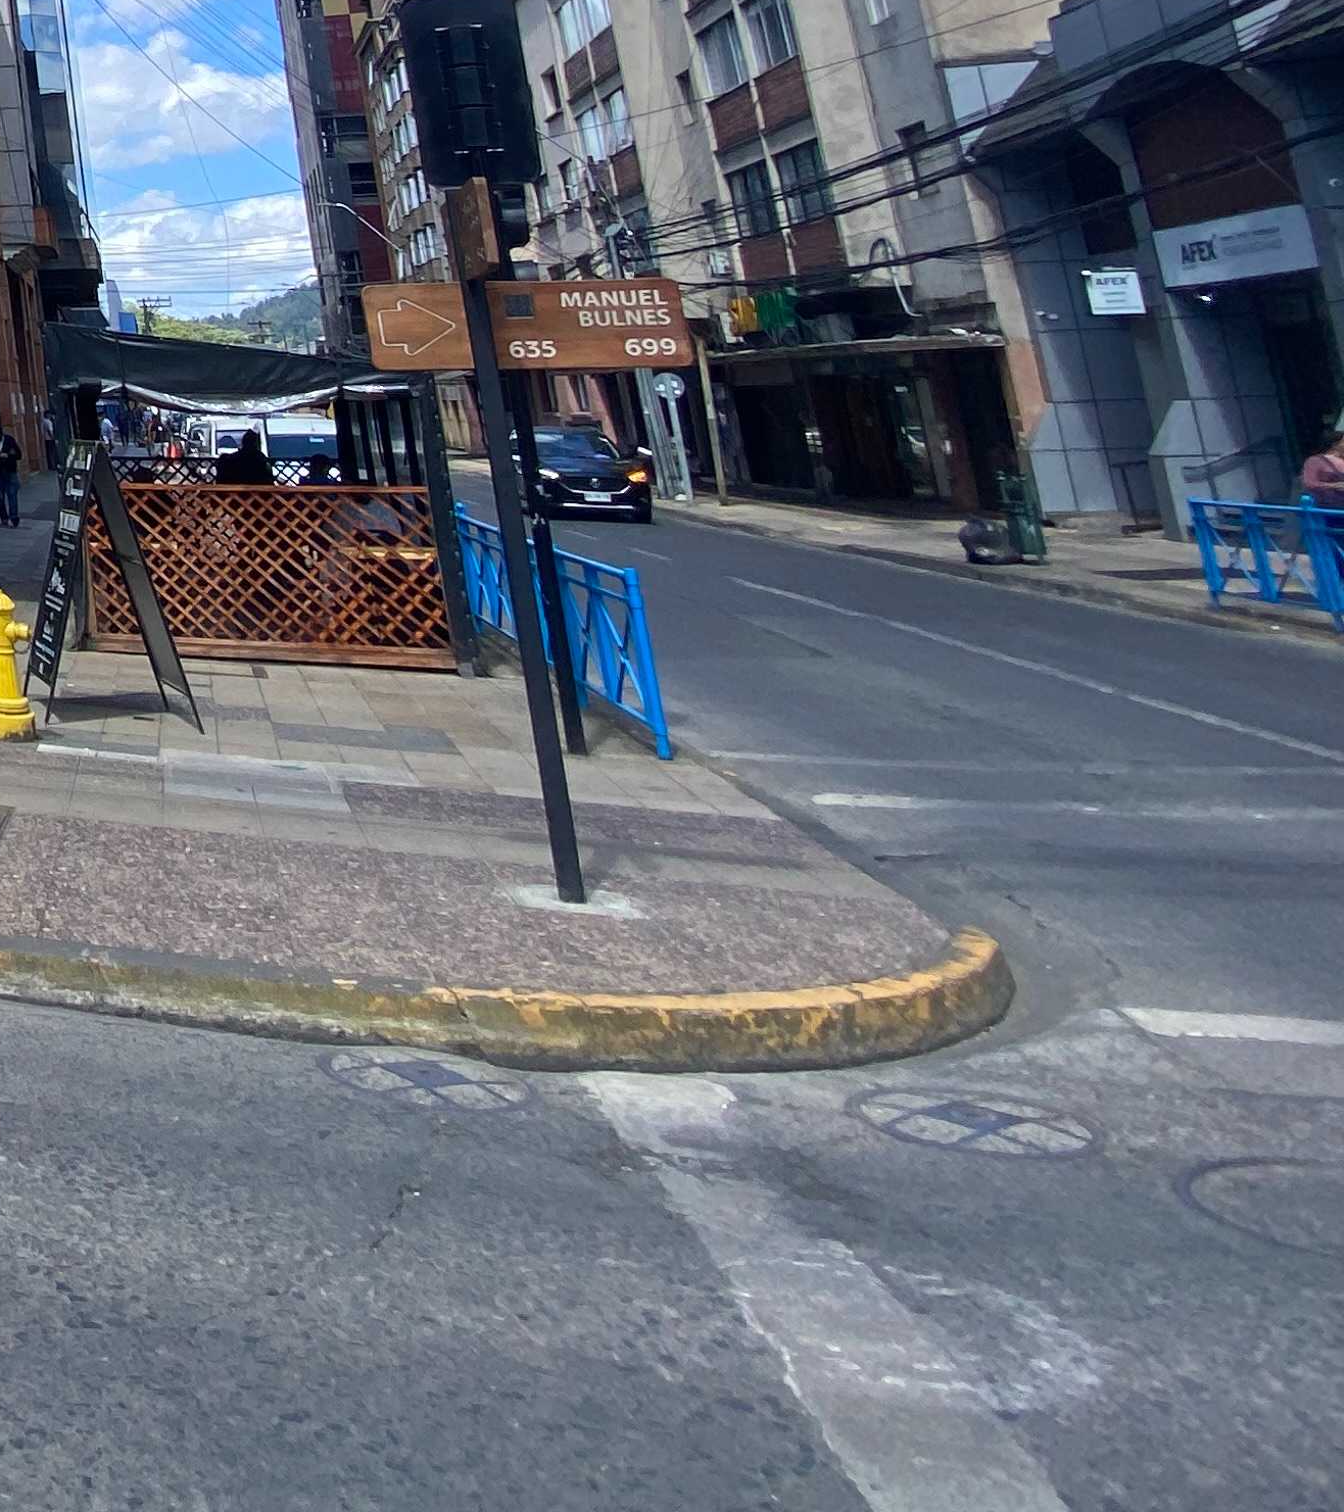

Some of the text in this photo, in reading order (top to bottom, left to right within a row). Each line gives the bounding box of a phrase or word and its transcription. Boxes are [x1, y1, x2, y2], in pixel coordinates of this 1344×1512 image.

[1180, 235, 1217, 265] AFEX
[1096, 275, 1130, 286] AFEX
[560, 289, 669, 308] MANUEL
[578, 309, 672, 327] BULNES
[508, 340, 558, 359] 635
[624, 338, 678, 357] 699
